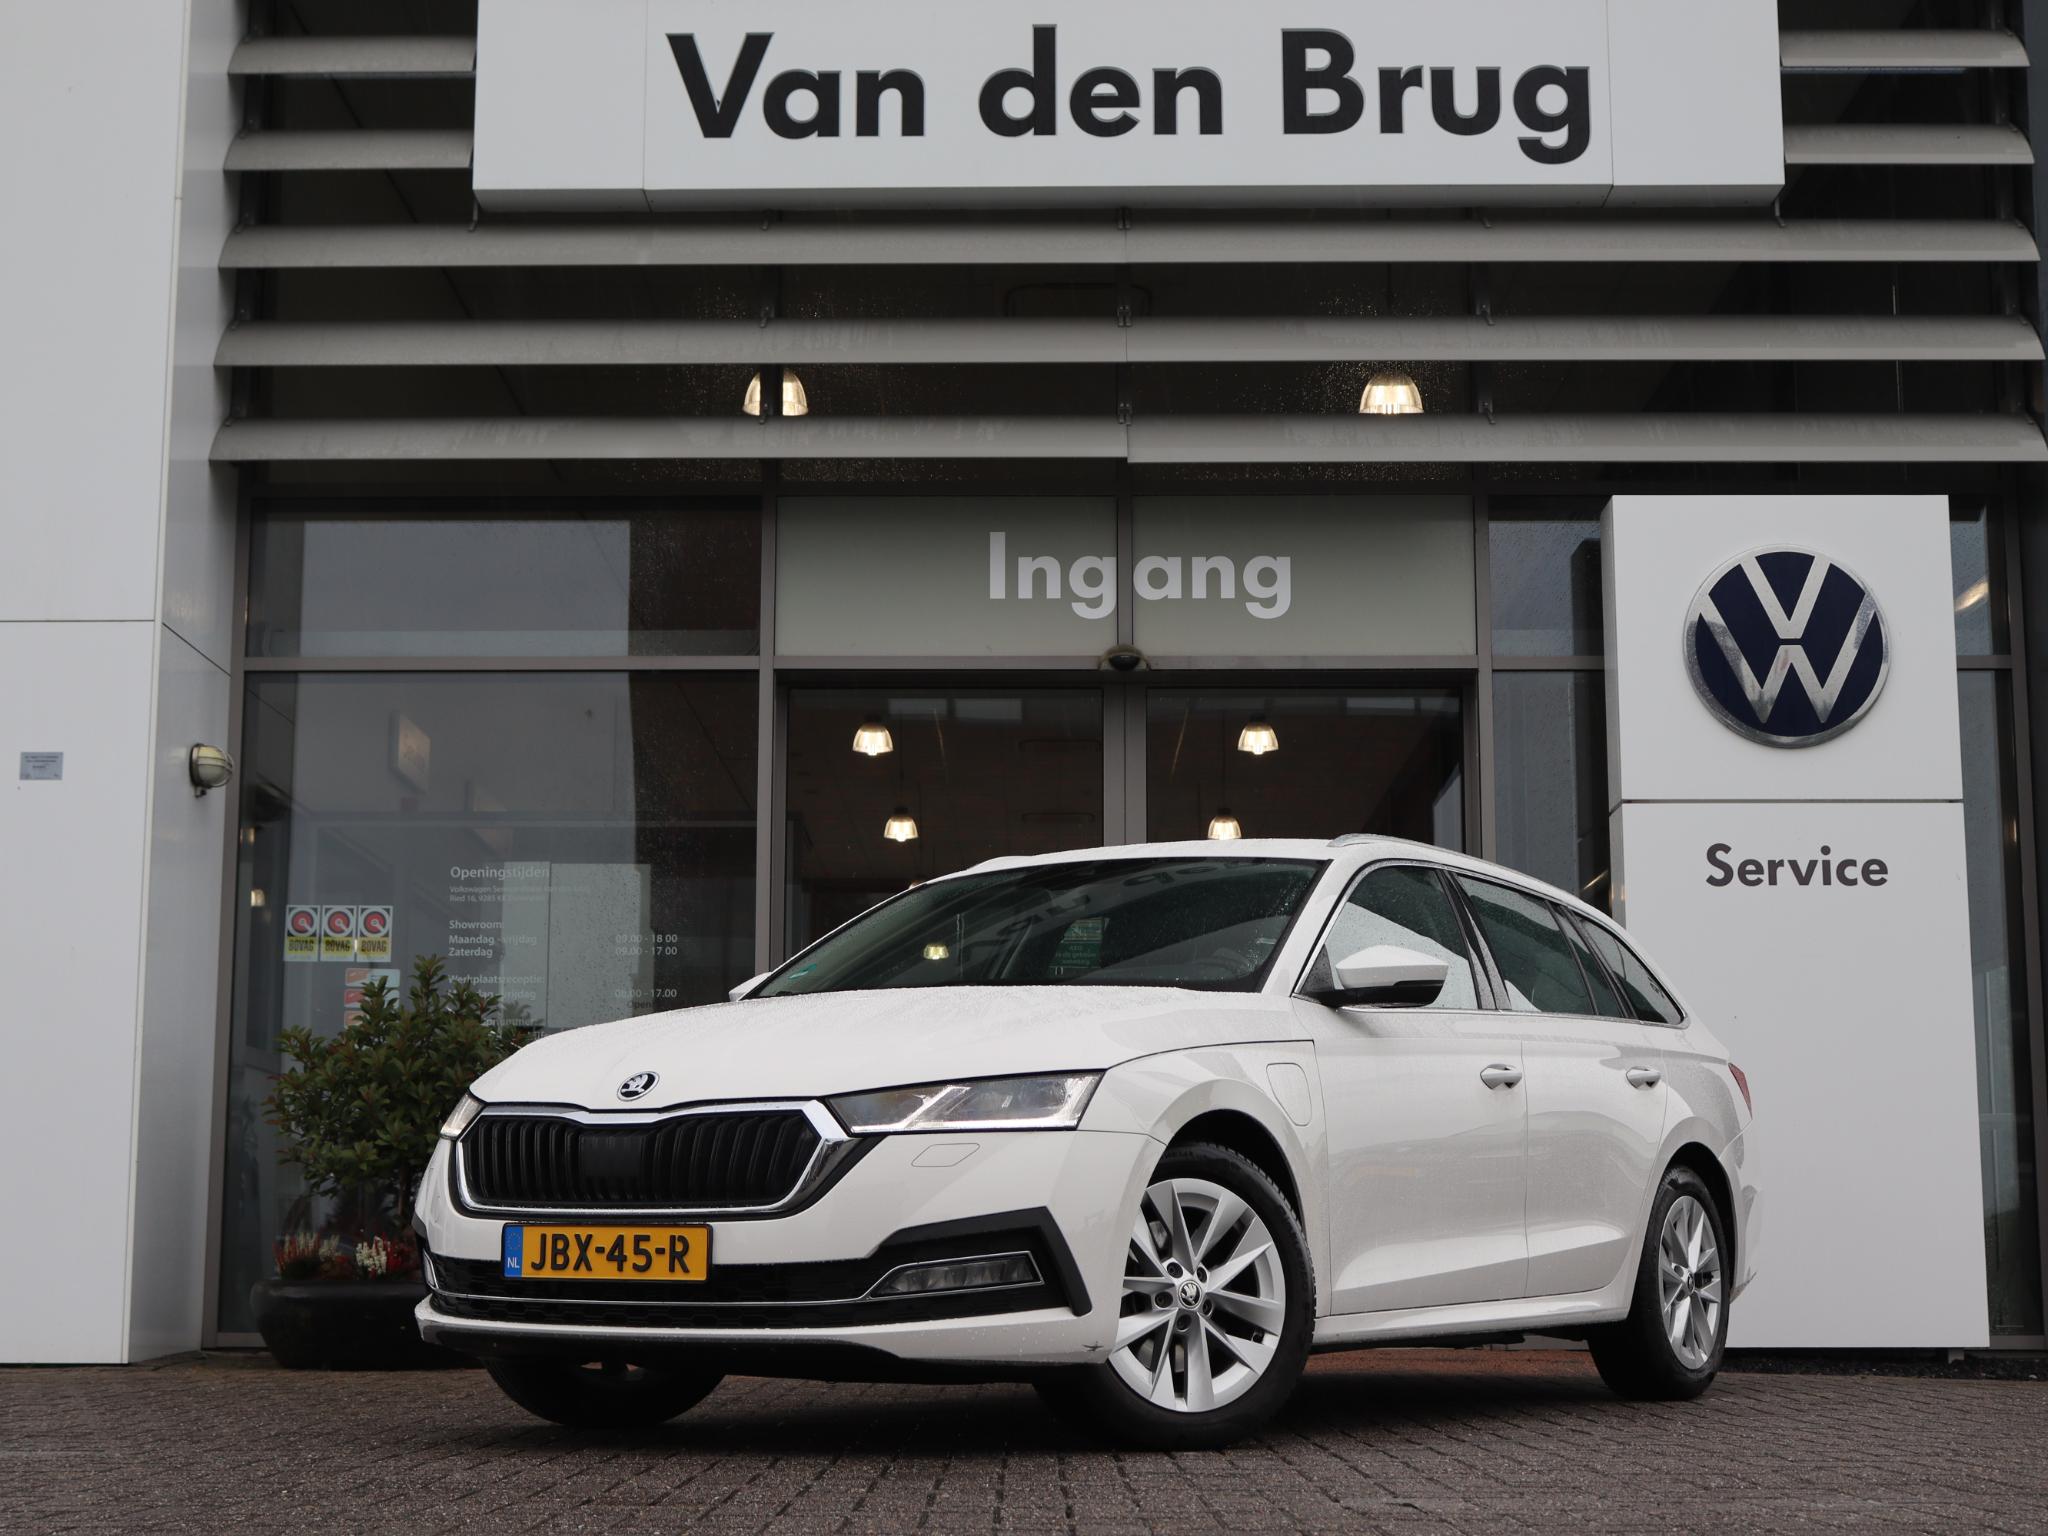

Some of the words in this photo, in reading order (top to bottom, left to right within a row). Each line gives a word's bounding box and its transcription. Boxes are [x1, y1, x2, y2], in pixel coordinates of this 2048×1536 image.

[665, 32, 926, 140] Van
[978, 24, 1224, 138] den
[1280, 28, 1592, 165] Brug
[989, 531, 1292, 620] Ingang
[1705, 843, 1889, 887] Service
[450, 866, 550, 880] Openingstijden
[361, 939, 387, 953] BOVAG
[448, 934, 495, 946] Maandag
[448, 947, 493, 958] Zaterdag
[651, 988, 677, 998] 17.00
[507, 1258, 520, 1269] NL
[531, 1232, 690, 1274] JBX-45-R
